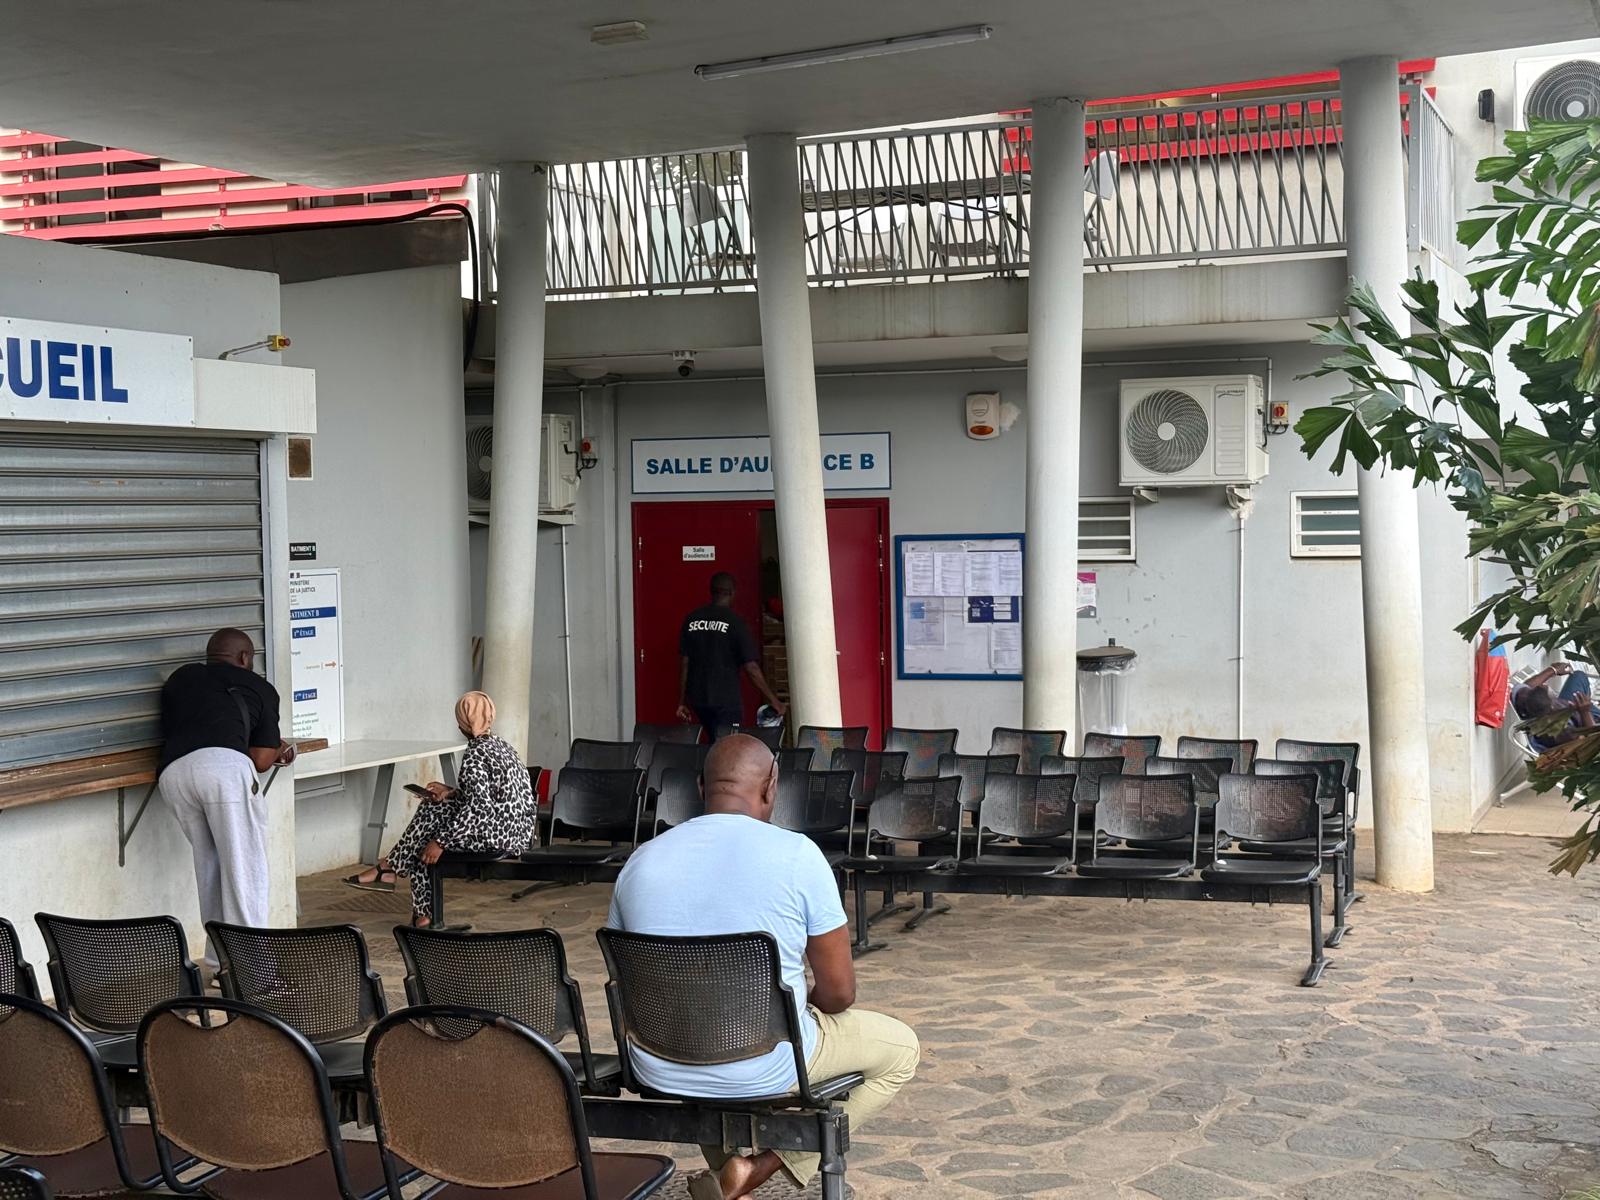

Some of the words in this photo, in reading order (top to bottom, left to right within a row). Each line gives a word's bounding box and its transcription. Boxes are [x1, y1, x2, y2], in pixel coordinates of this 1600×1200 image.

[0, 337, 129, 404] UEIL
[646, 457, 712, 475] SALLE
[719, 453, 853, 473] D'AUCE
[860, 453, 875, 470] B
[315, 609, 320, 617] B
[688, 619, 730, 633] SECURITE
